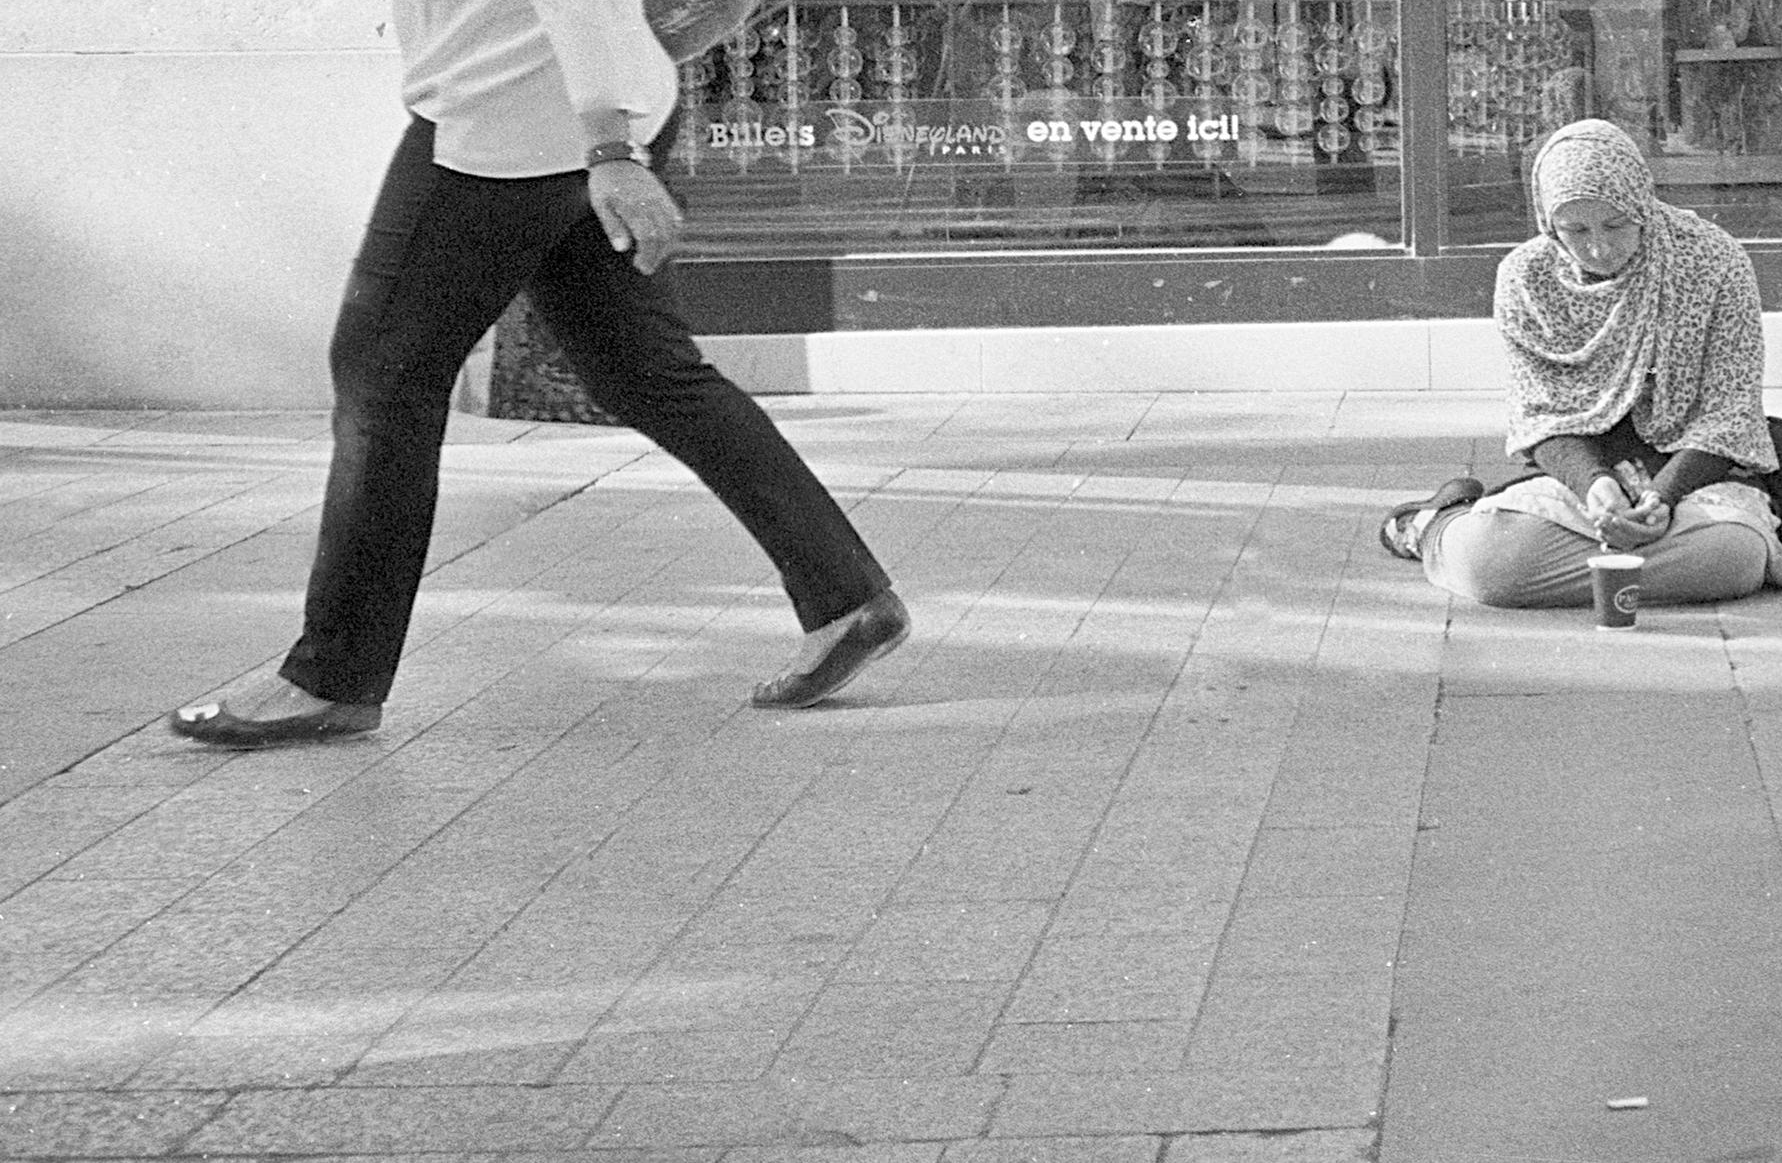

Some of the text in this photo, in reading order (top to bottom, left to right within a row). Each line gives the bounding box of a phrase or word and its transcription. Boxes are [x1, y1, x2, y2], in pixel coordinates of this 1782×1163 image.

[710, 122, 816, 148] Billets
[1026, 120, 1073, 142] en
[1079, 114, 1179, 142] vente
[1186, 113, 1240, 141] ici!
[941, 144, 1007, 155] PARIS
